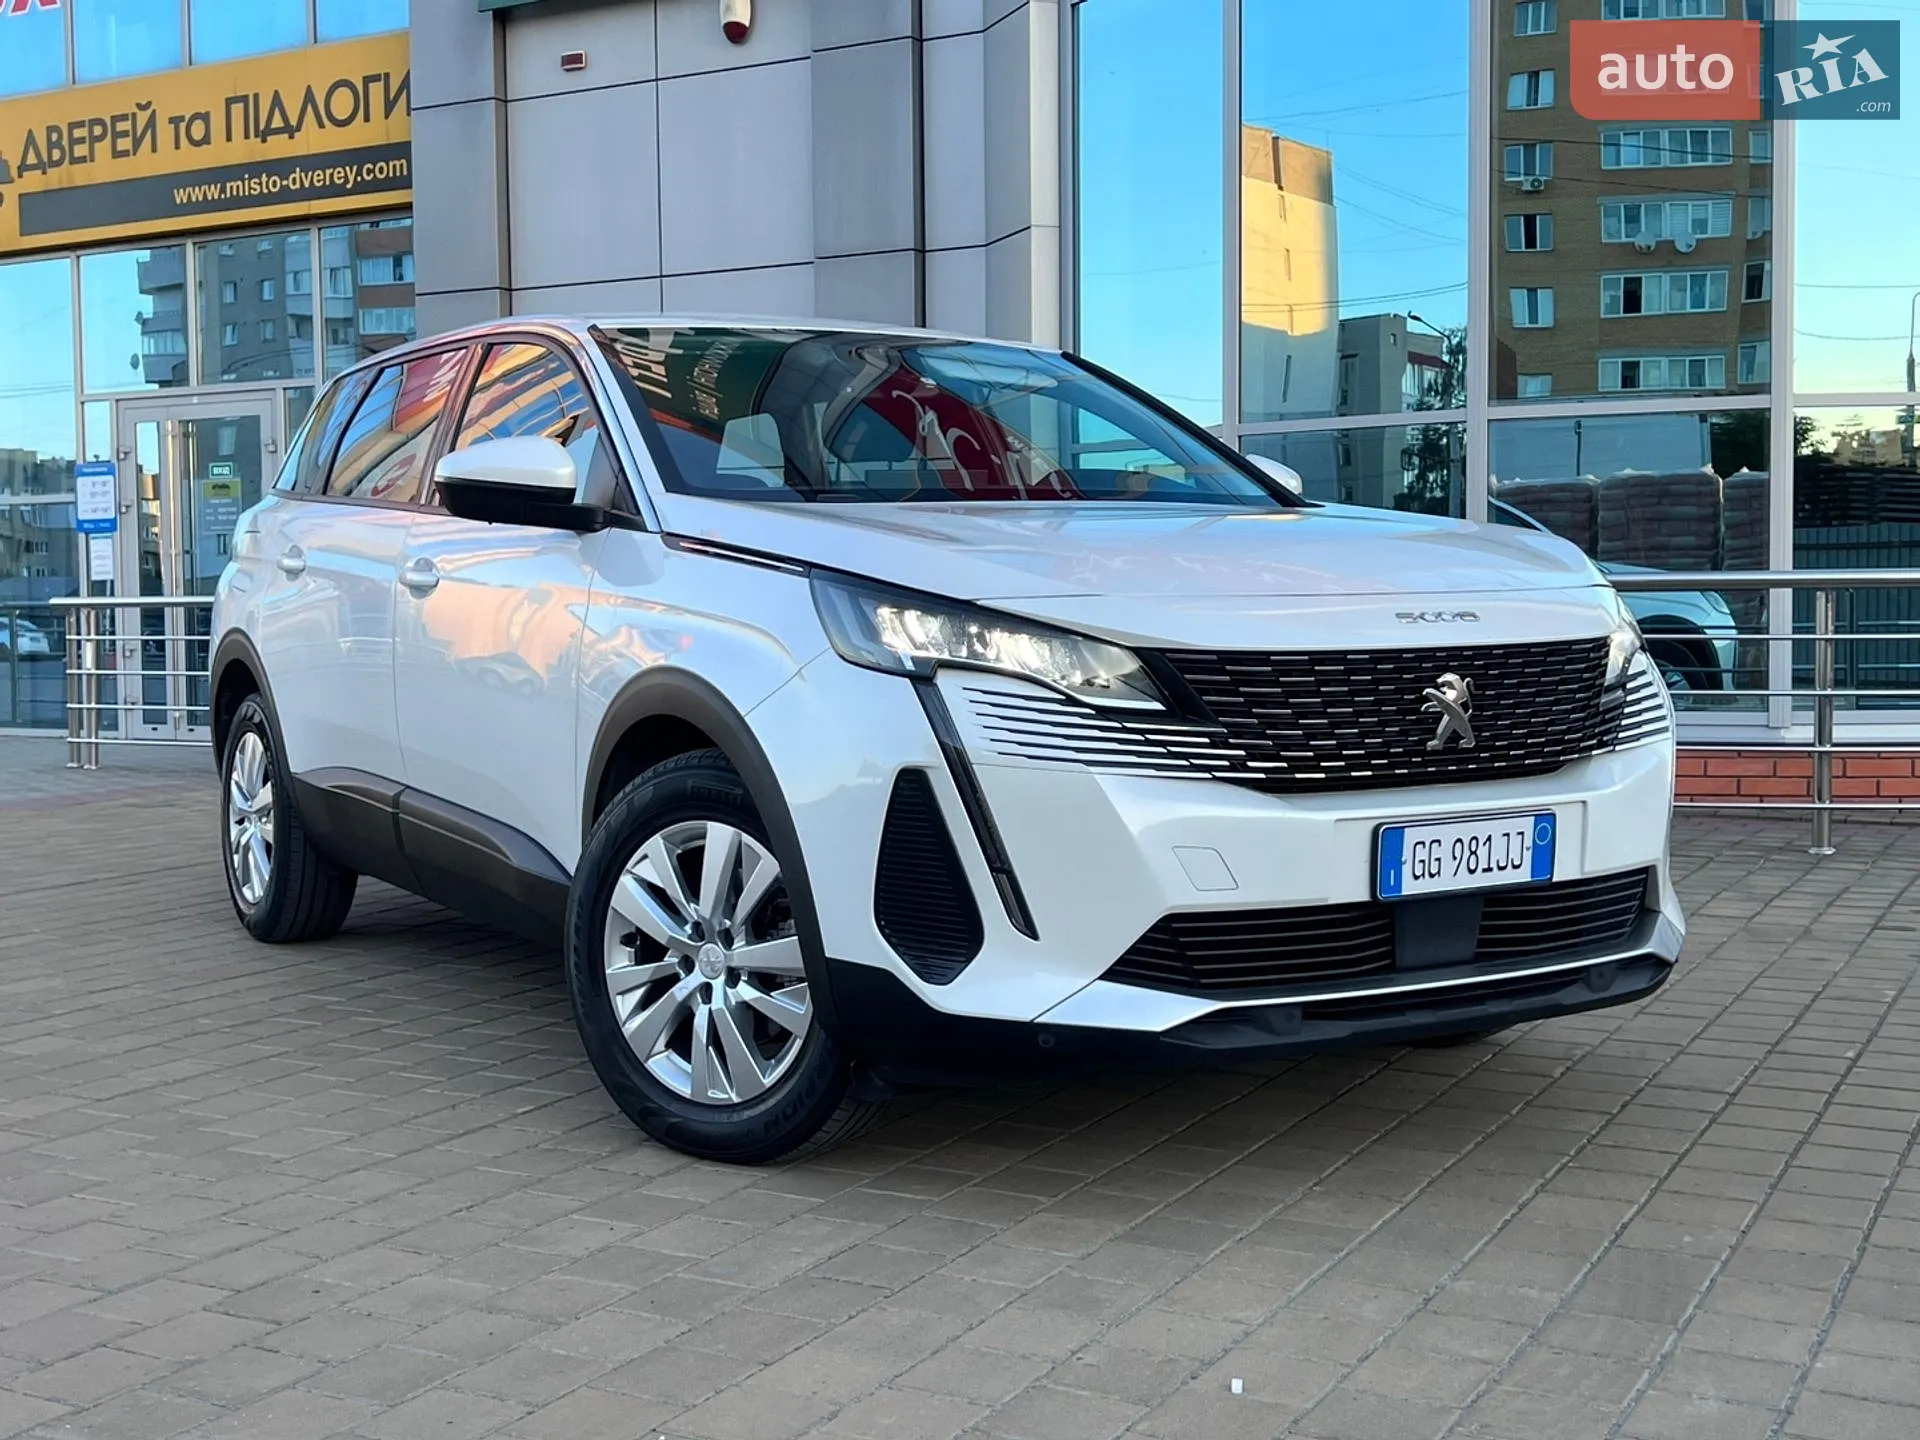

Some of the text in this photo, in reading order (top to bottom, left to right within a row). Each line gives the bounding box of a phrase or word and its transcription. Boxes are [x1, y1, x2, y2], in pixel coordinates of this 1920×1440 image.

[17, 68, 411, 178] ДВЕРЕЙ та ПІДЛОГИ
[173, 157, 408, 204] www.misto-dverey.com
[1412, 831, 1526, 881] GG 981JJ
